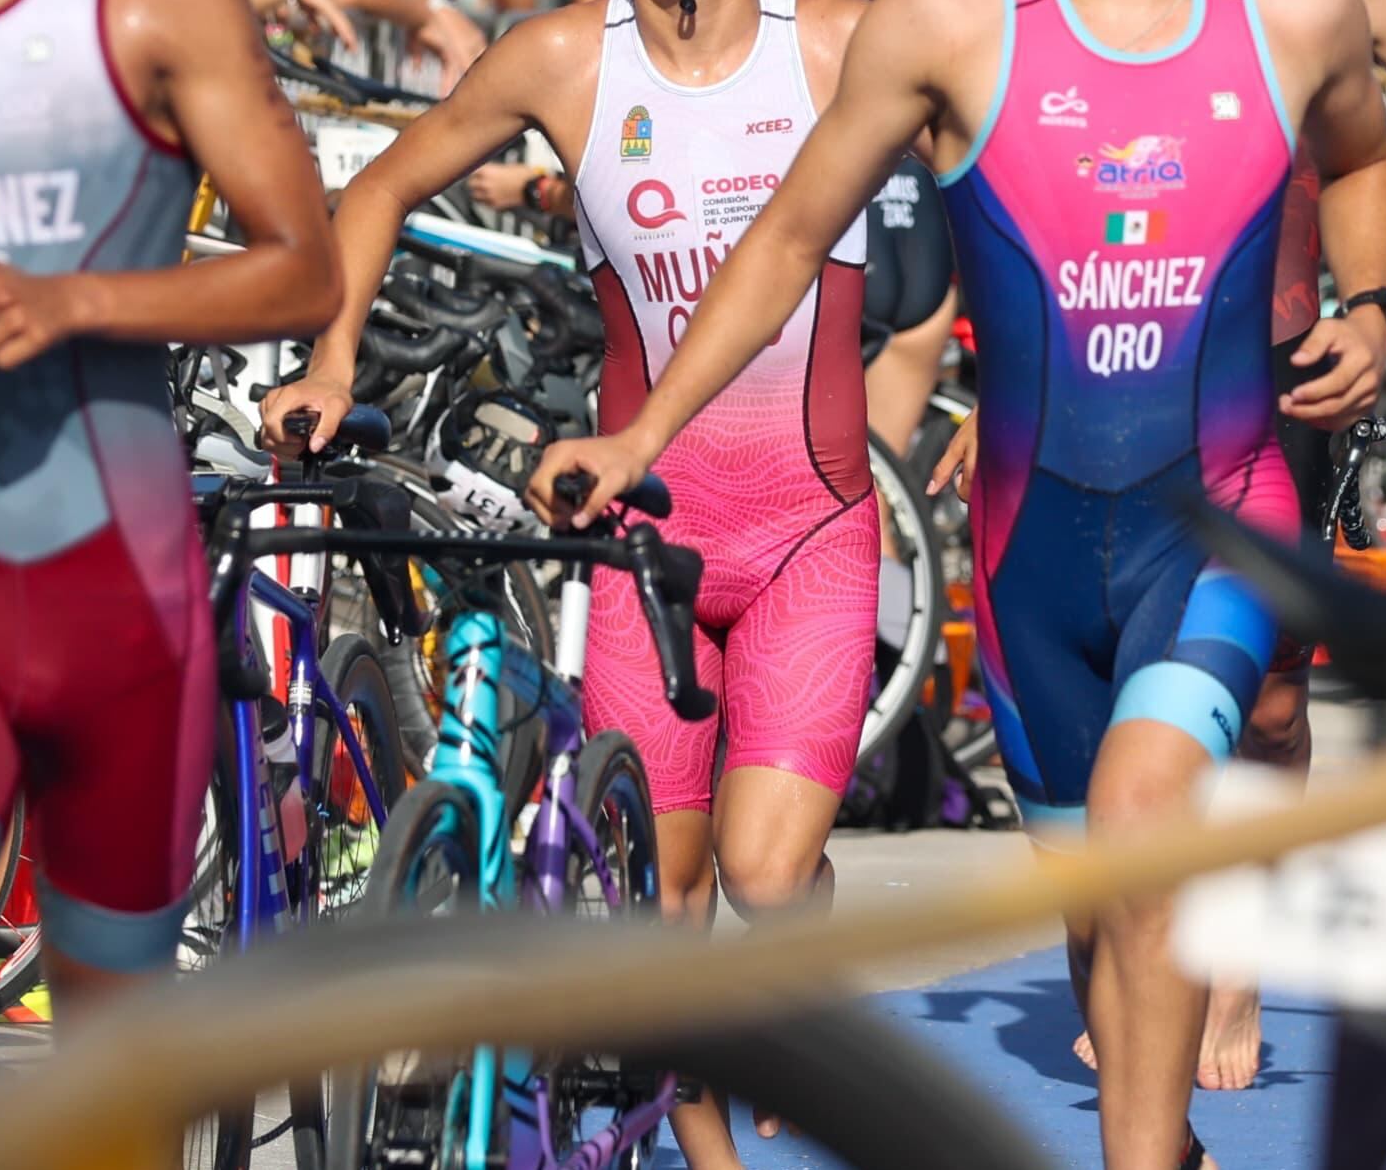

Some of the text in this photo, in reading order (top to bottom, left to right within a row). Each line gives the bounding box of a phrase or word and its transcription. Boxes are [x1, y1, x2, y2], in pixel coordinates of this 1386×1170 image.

[702, 194, 750, 207] COMISIÓN
[703, 207, 721, 216] DEL
[704, 215, 757, 226] DE QUINTA
[634, 230, 733, 303] MUÑ
[1058, 250, 1206, 311] SÁNCHEZ
[1086, 321, 1163, 378] QRO
[465, 489, 507, 519] 131
